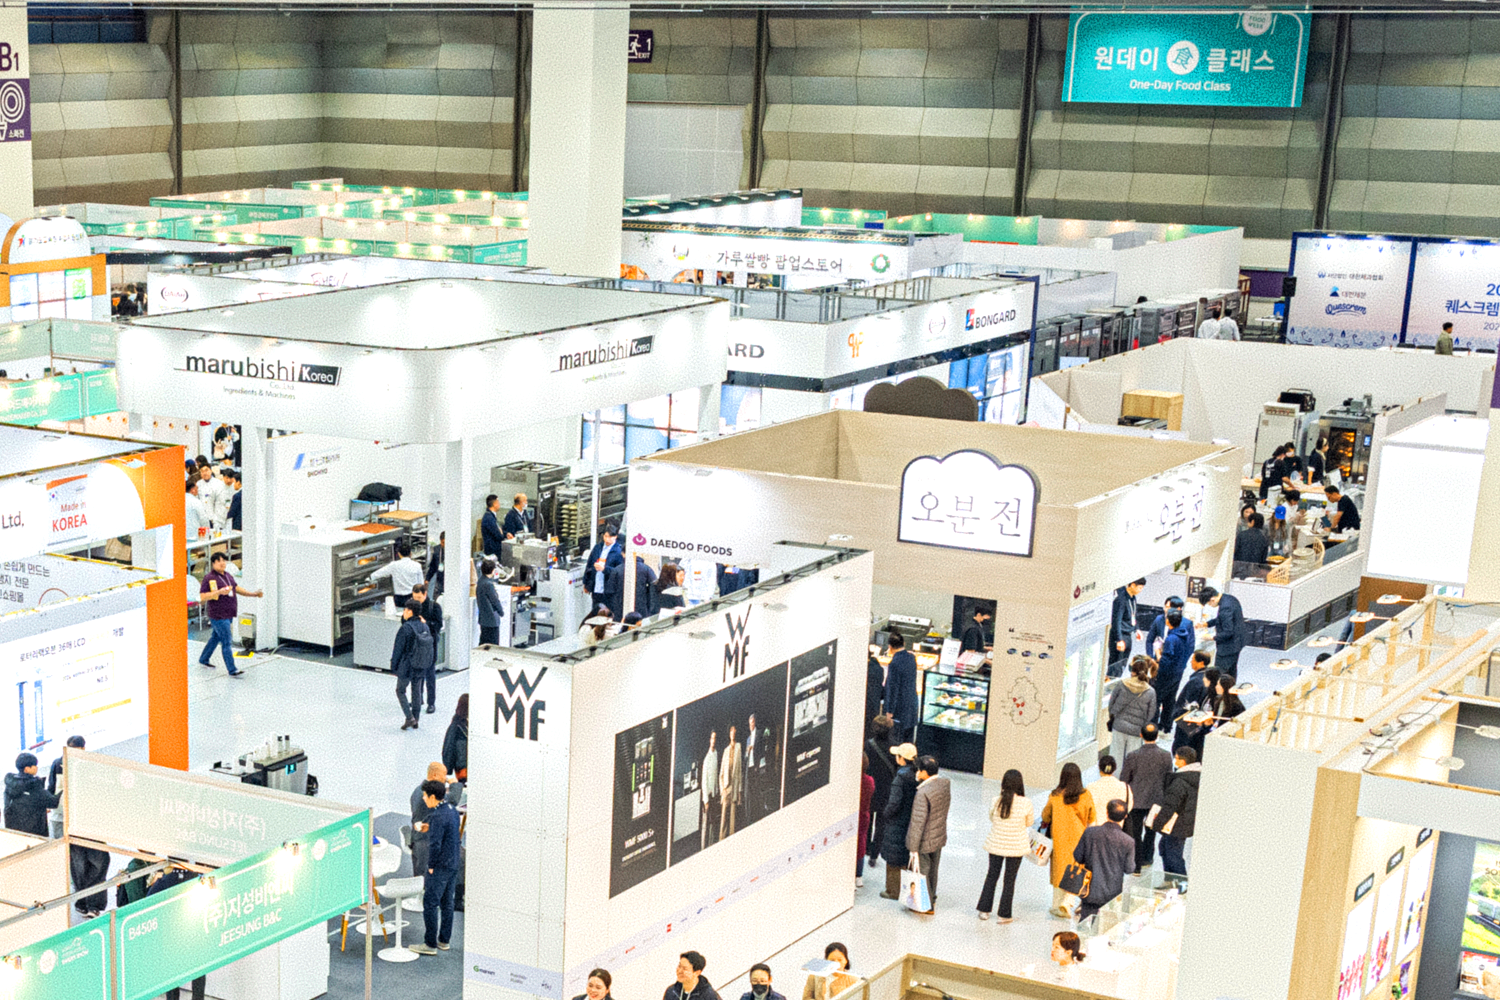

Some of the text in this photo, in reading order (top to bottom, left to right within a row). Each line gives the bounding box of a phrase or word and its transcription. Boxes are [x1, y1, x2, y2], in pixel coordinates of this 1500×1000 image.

[646, 38, 651, 51] 1
[1094, 46, 1159, 71] 원데이
[1206, 48, 1275, 73] 클래스
[1129, 78, 1231, 92] One-Day Food Class
[8, 129, 24, 138] 소화전
[717, 250, 843, 273] 가루쌀빵 팝업스토어
[975, 309, 1017, 329] BONGARD
[559, 339, 651, 371] marubishi Korea
[186, 355, 334, 384] marubishi Korea
[223, 386, 258, 397] Ingredients
[61, 502, 79, 513] Made
[912, 491, 1021, 538] 오분전
[1153, 485, 1204, 544] 오분전
[52, 513, 88, 532] KOREA
[650, 538, 733, 557] DAEDOO FOODS
[28, 563, 51, 578] 만드는
[15, 575, 30, 590] 전문
[74, 637, 86, 648] LCD
[128, 917, 158, 942] B4506
[218, 908, 283, 947] JEESUNG B&C
